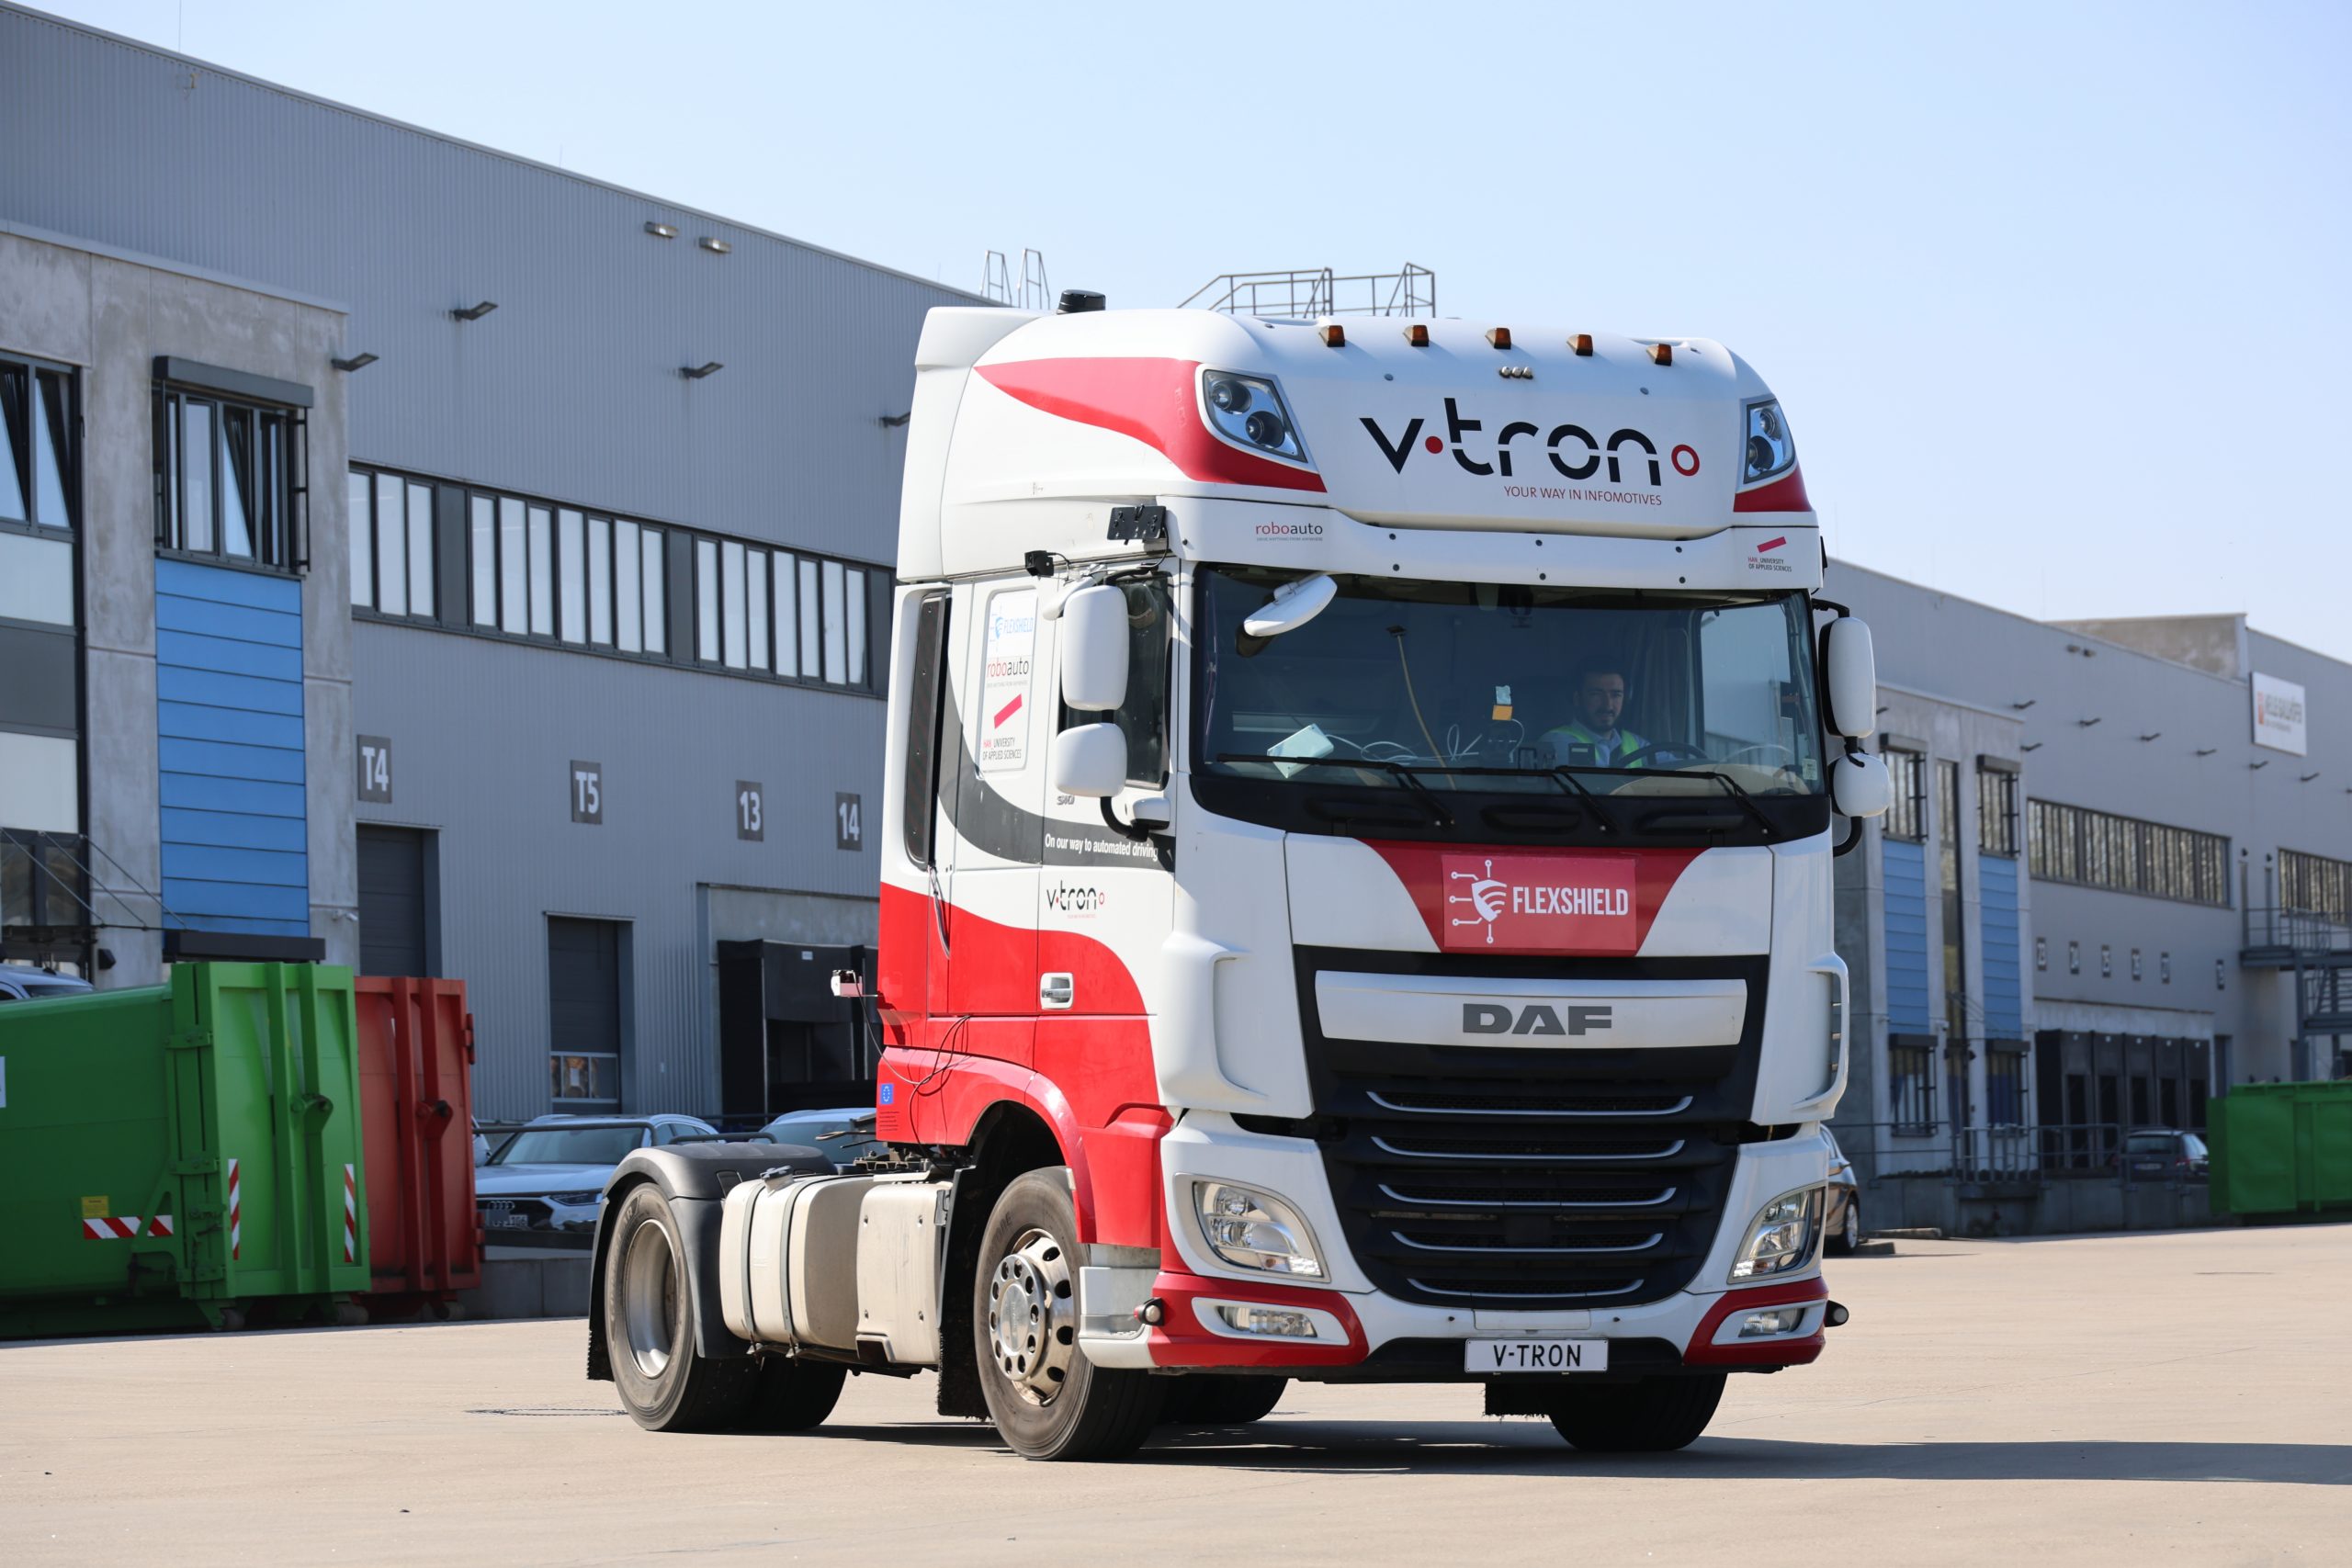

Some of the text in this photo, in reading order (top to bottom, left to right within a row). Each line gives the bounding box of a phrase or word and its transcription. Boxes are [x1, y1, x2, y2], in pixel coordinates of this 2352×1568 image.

[1504, 486, 1662, 505] YOUR WAY IN INFOMOTIVES
[1255, 521, 1323, 535] roboauto
[986, 657, 1030, 678] roboauto
[362, 746, 389, 792] T4
[575, 771, 600, 814] T5
[740, 791, 761, 831] 13
[839, 802, 860, 841] 14
[1045, 833, 1159, 862] On our way to automated driving
[1512, 886, 1629, 916] FLEXSHIELD
[1463, 1003, 1612, 1035] DAF
[1493, 1344, 1581, 1368] V-TRON
